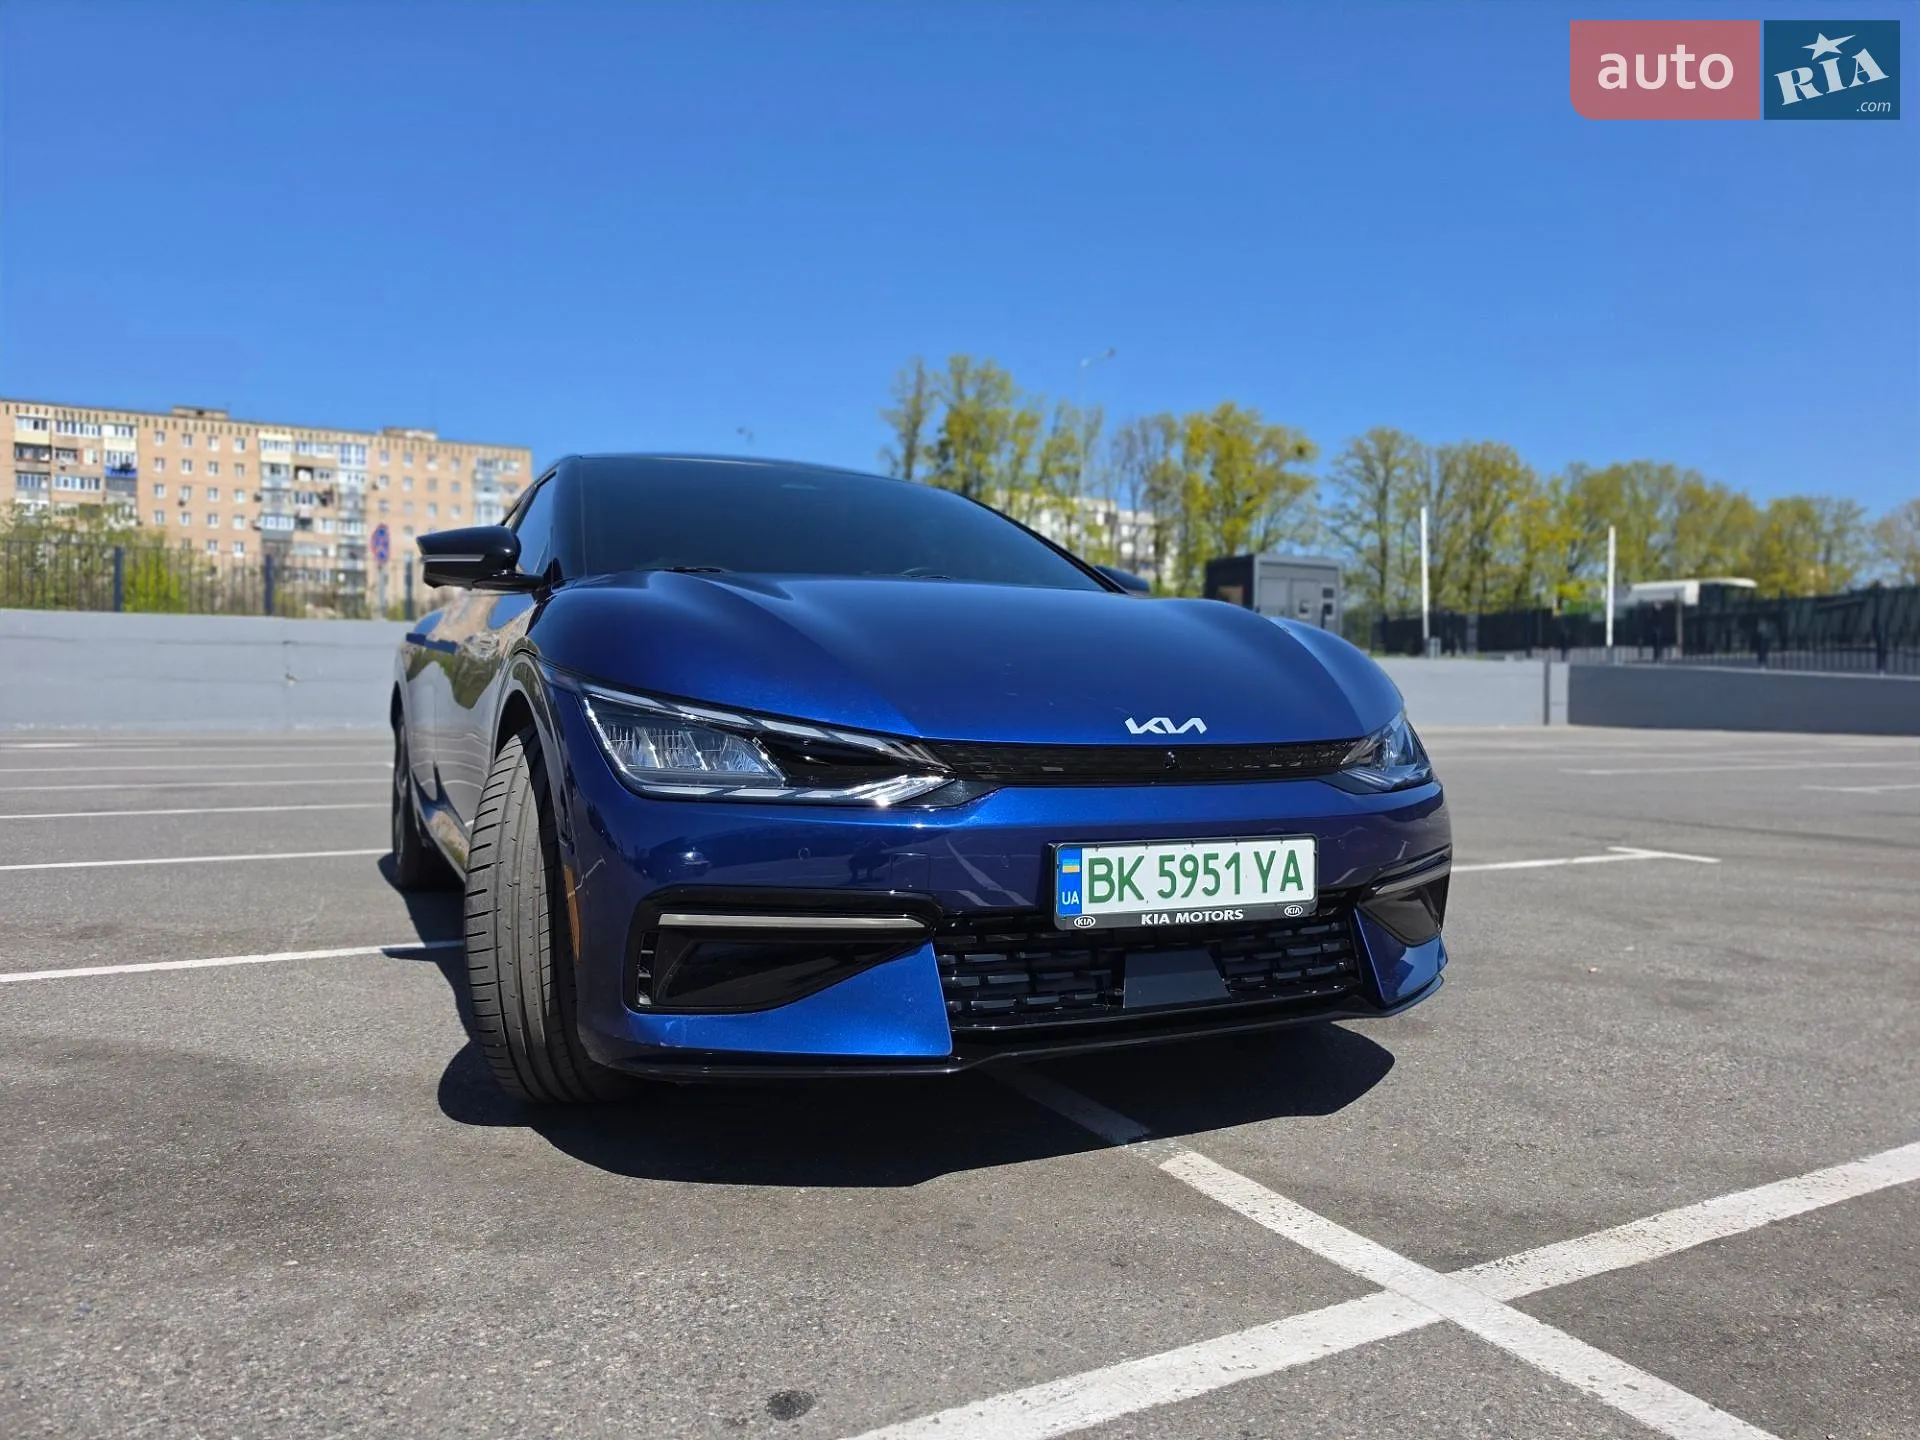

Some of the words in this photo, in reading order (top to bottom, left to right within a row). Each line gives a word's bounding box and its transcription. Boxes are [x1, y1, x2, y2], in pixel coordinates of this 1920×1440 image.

[1124, 717, 1208, 735] KIA
[1087, 855, 1145, 904] BK
[1157, 851, 1241, 899] 5951
[1253, 849, 1304, 893] YA
[1061, 890, 1080, 905] UA
[1076, 916, 1094, 926] KIA
[1140, 913, 1173, 925] KIA
[1175, 909, 1244, 924] MOTORS
